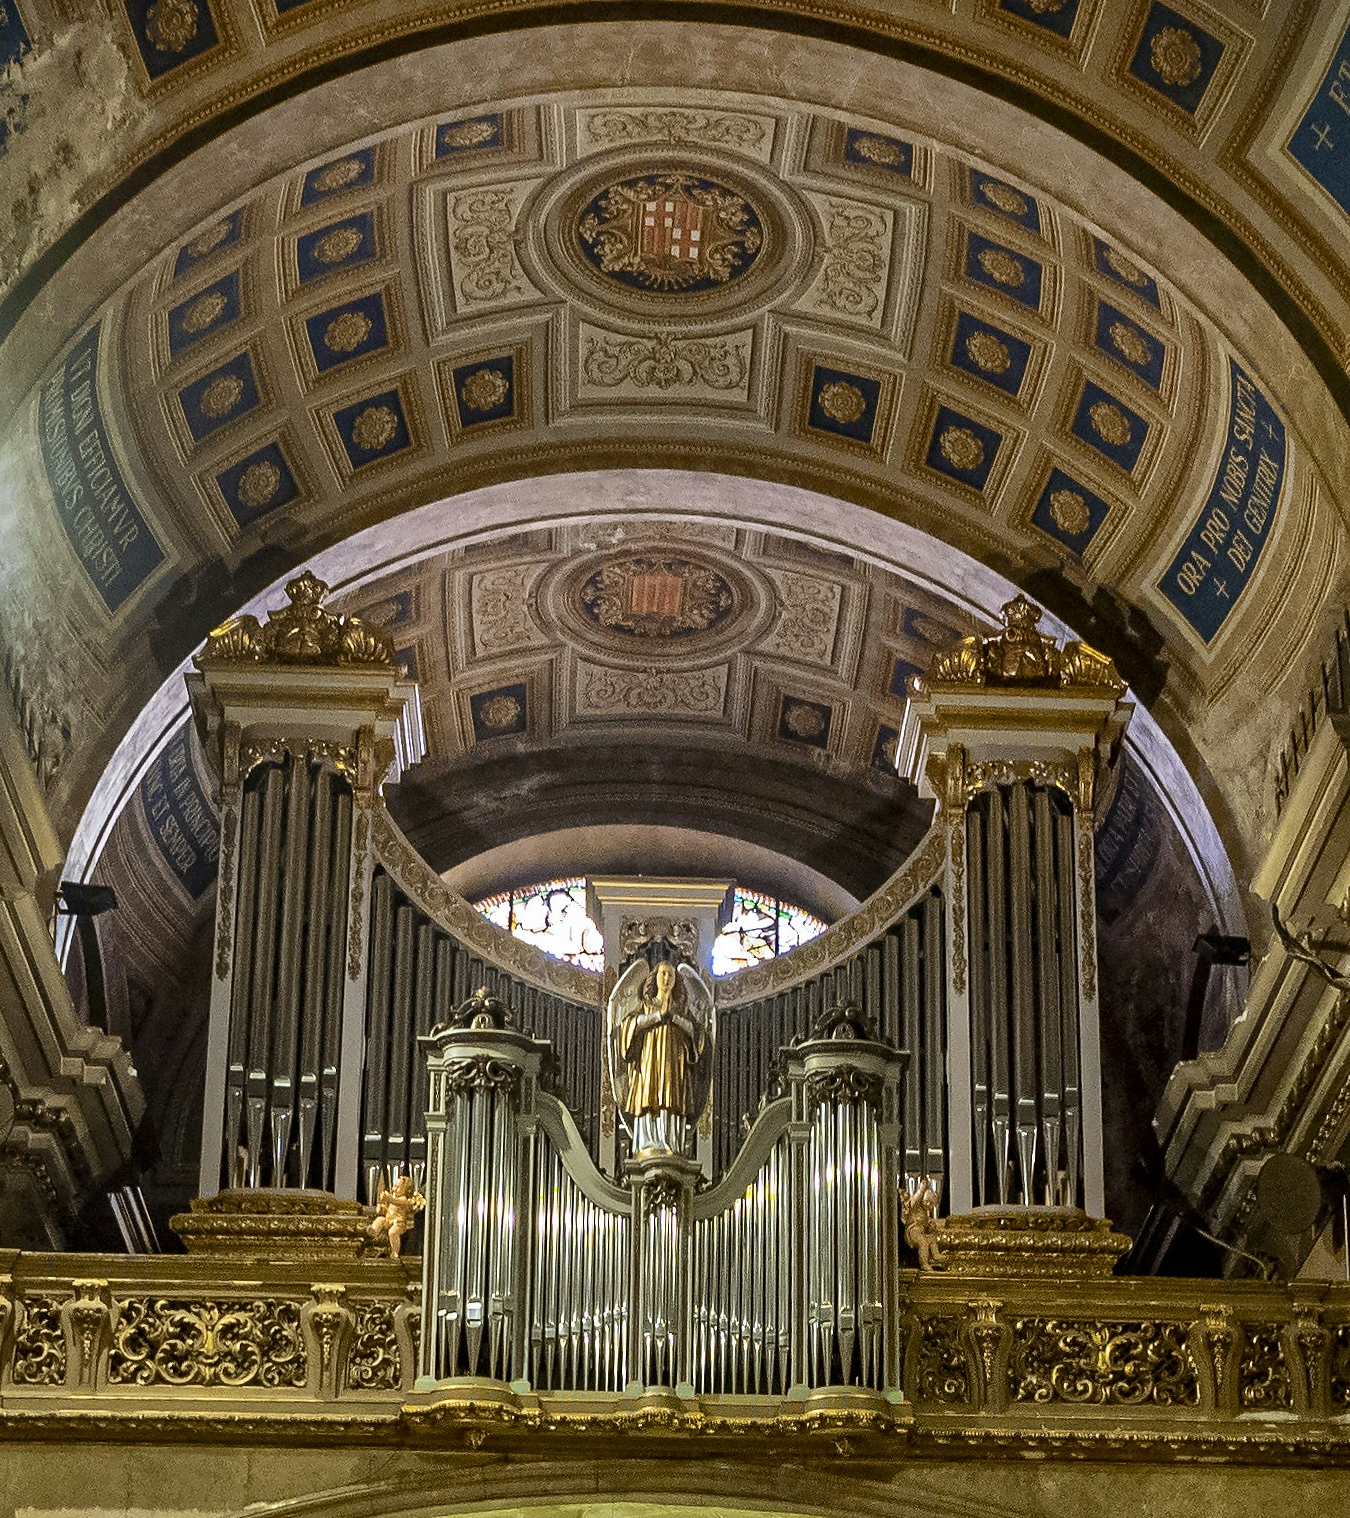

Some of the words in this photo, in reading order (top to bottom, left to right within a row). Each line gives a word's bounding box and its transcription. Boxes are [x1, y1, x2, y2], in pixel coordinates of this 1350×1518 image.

[78, 429, 139, 551] EFFICIAMVR
[1176, 551, 1211, 597] ORA
[1200, 508, 1231, 555] PRO
[1220, 447, 1251, 510] NOBIS
[1227, 529, 1253, 574] DEI
[1244, 449, 1280, 536] GENITRIX
